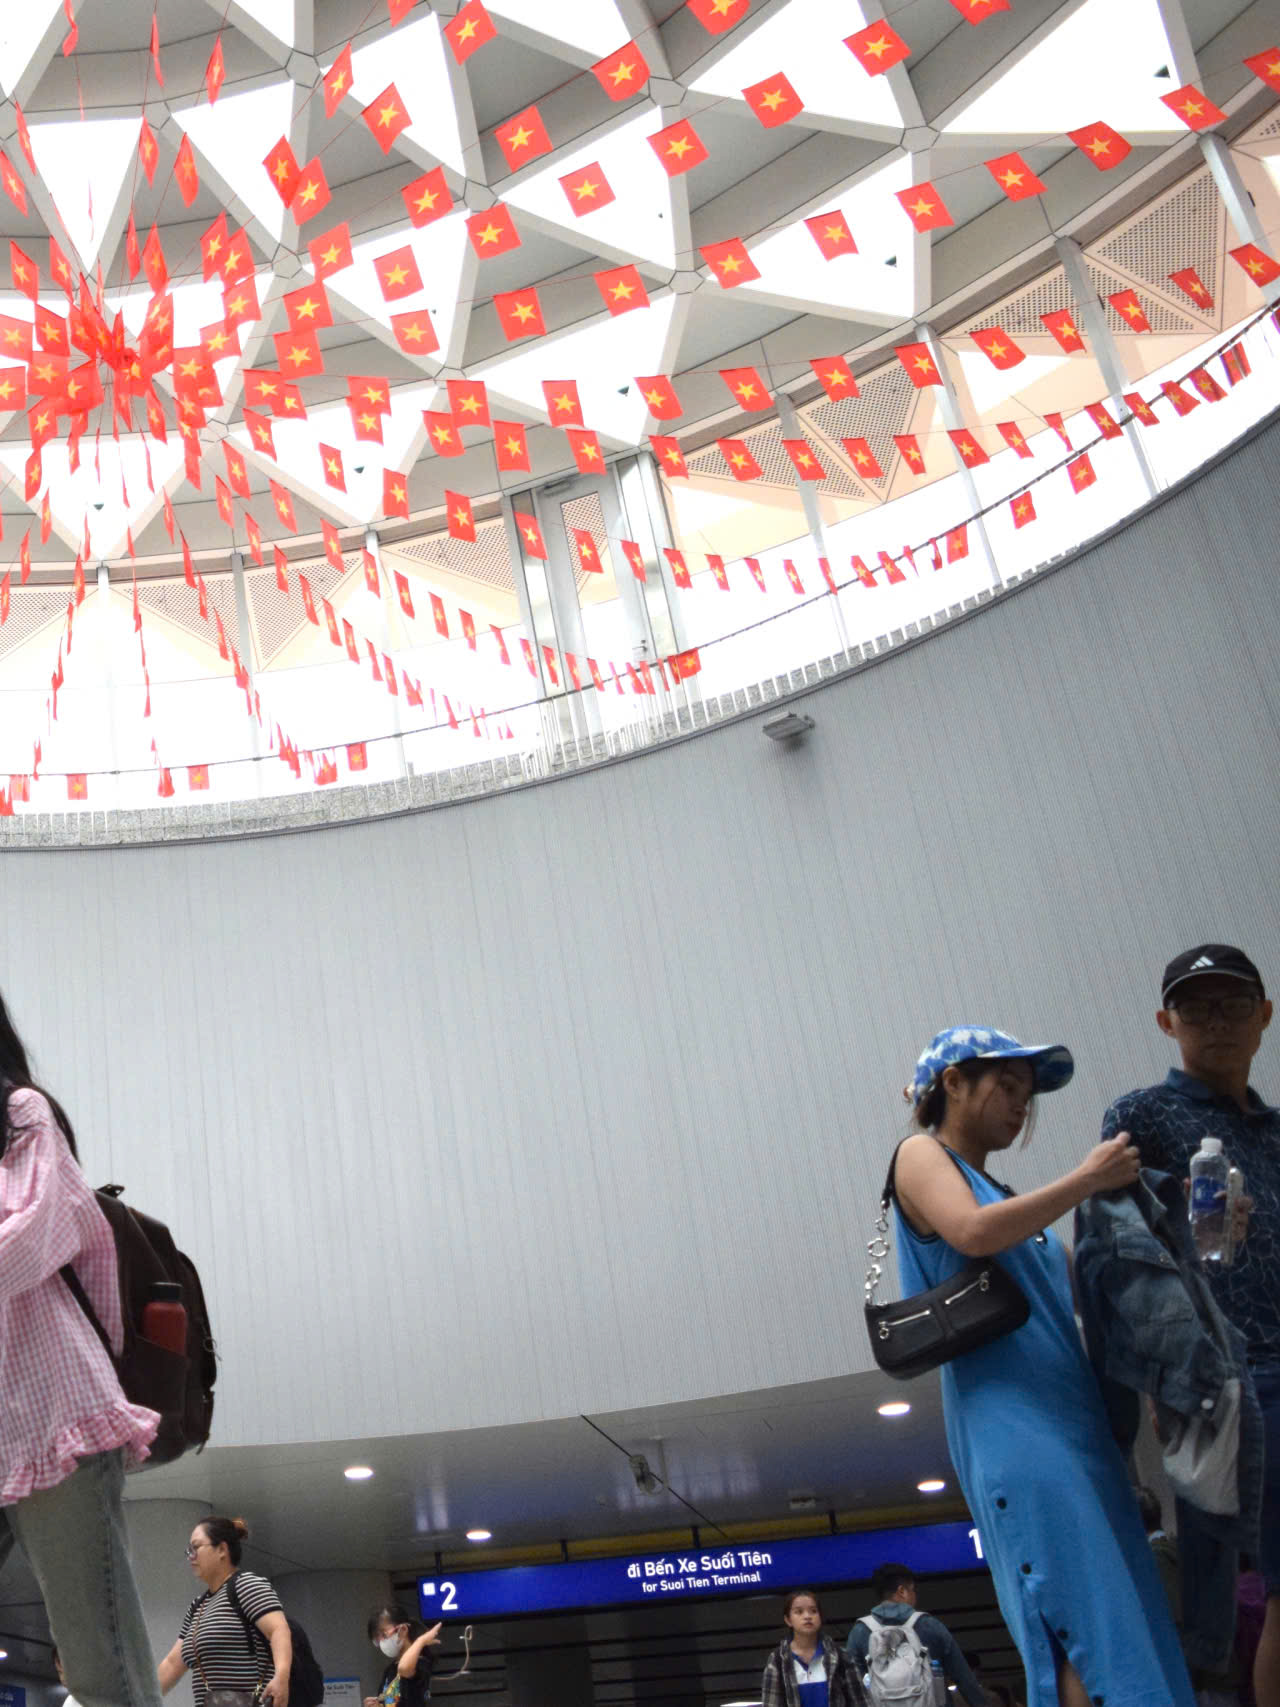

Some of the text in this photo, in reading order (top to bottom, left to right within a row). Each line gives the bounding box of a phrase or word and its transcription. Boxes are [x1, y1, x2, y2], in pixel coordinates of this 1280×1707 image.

[968, 1528, 983, 1559] 1
[626, 1551, 772, 1579] đi Bến Xe Suối Tiên
[439, 1581, 458, 1611] 2
[642, 1571, 761, 1593] for Suoi Tien Terminal
